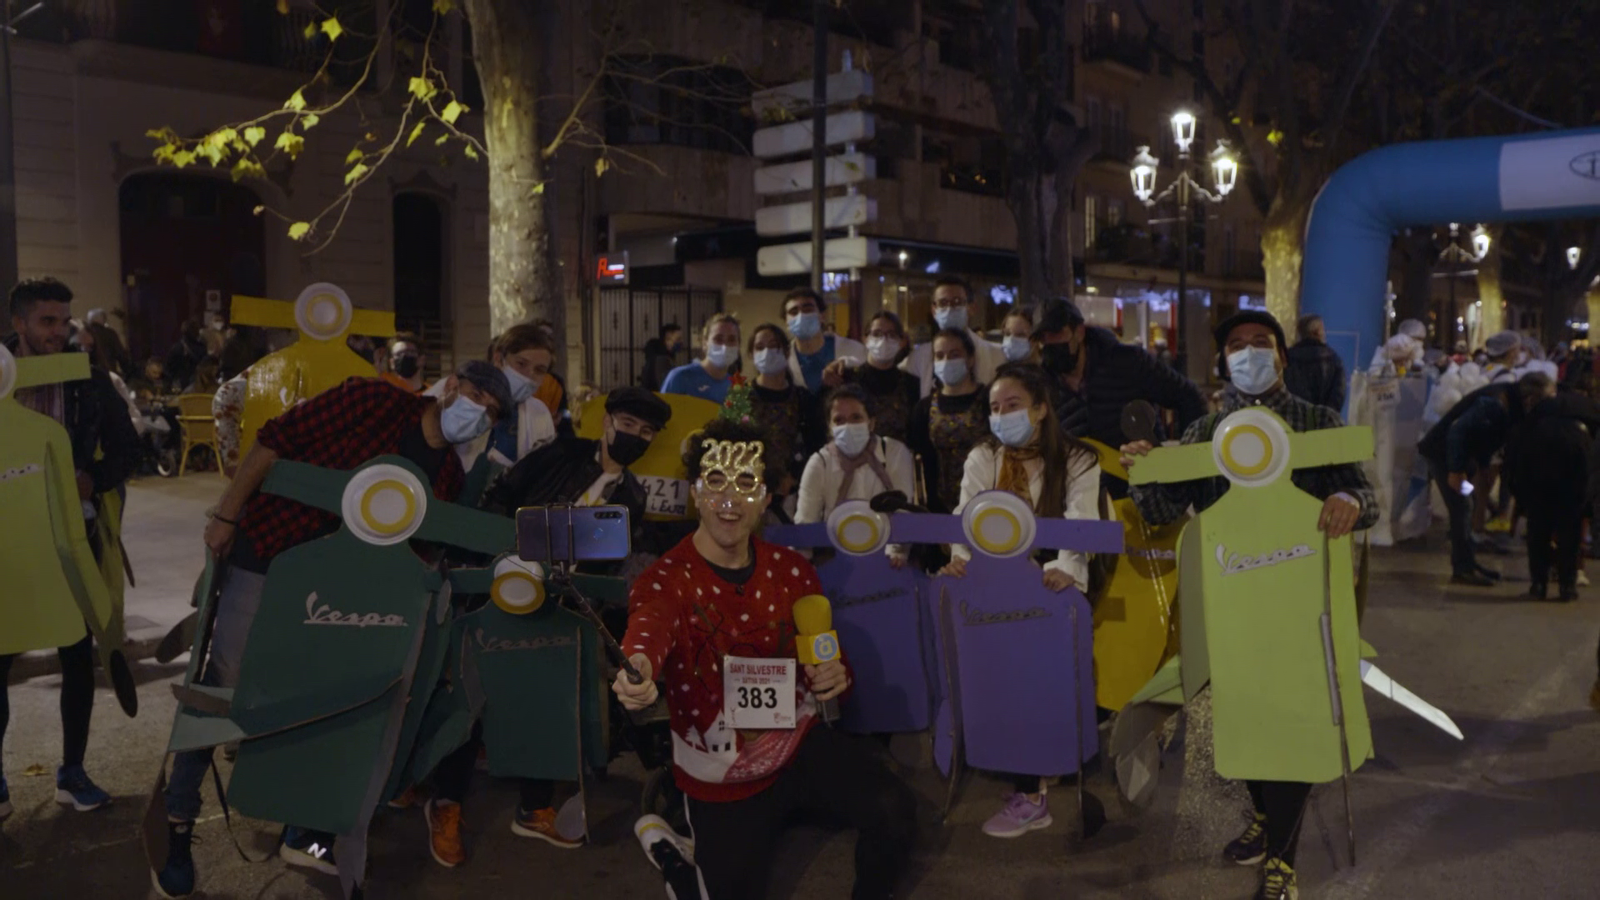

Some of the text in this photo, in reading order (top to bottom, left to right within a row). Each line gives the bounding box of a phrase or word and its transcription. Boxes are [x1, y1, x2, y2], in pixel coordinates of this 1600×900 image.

[700, 438, 765, 469] 2022
[1215, 543, 1316, 577] Vespa
[303, 591, 408, 628] Vespa
[729, 663, 787, 675] SANT SILVESTRE
[737, 686, 778, 709] 383
